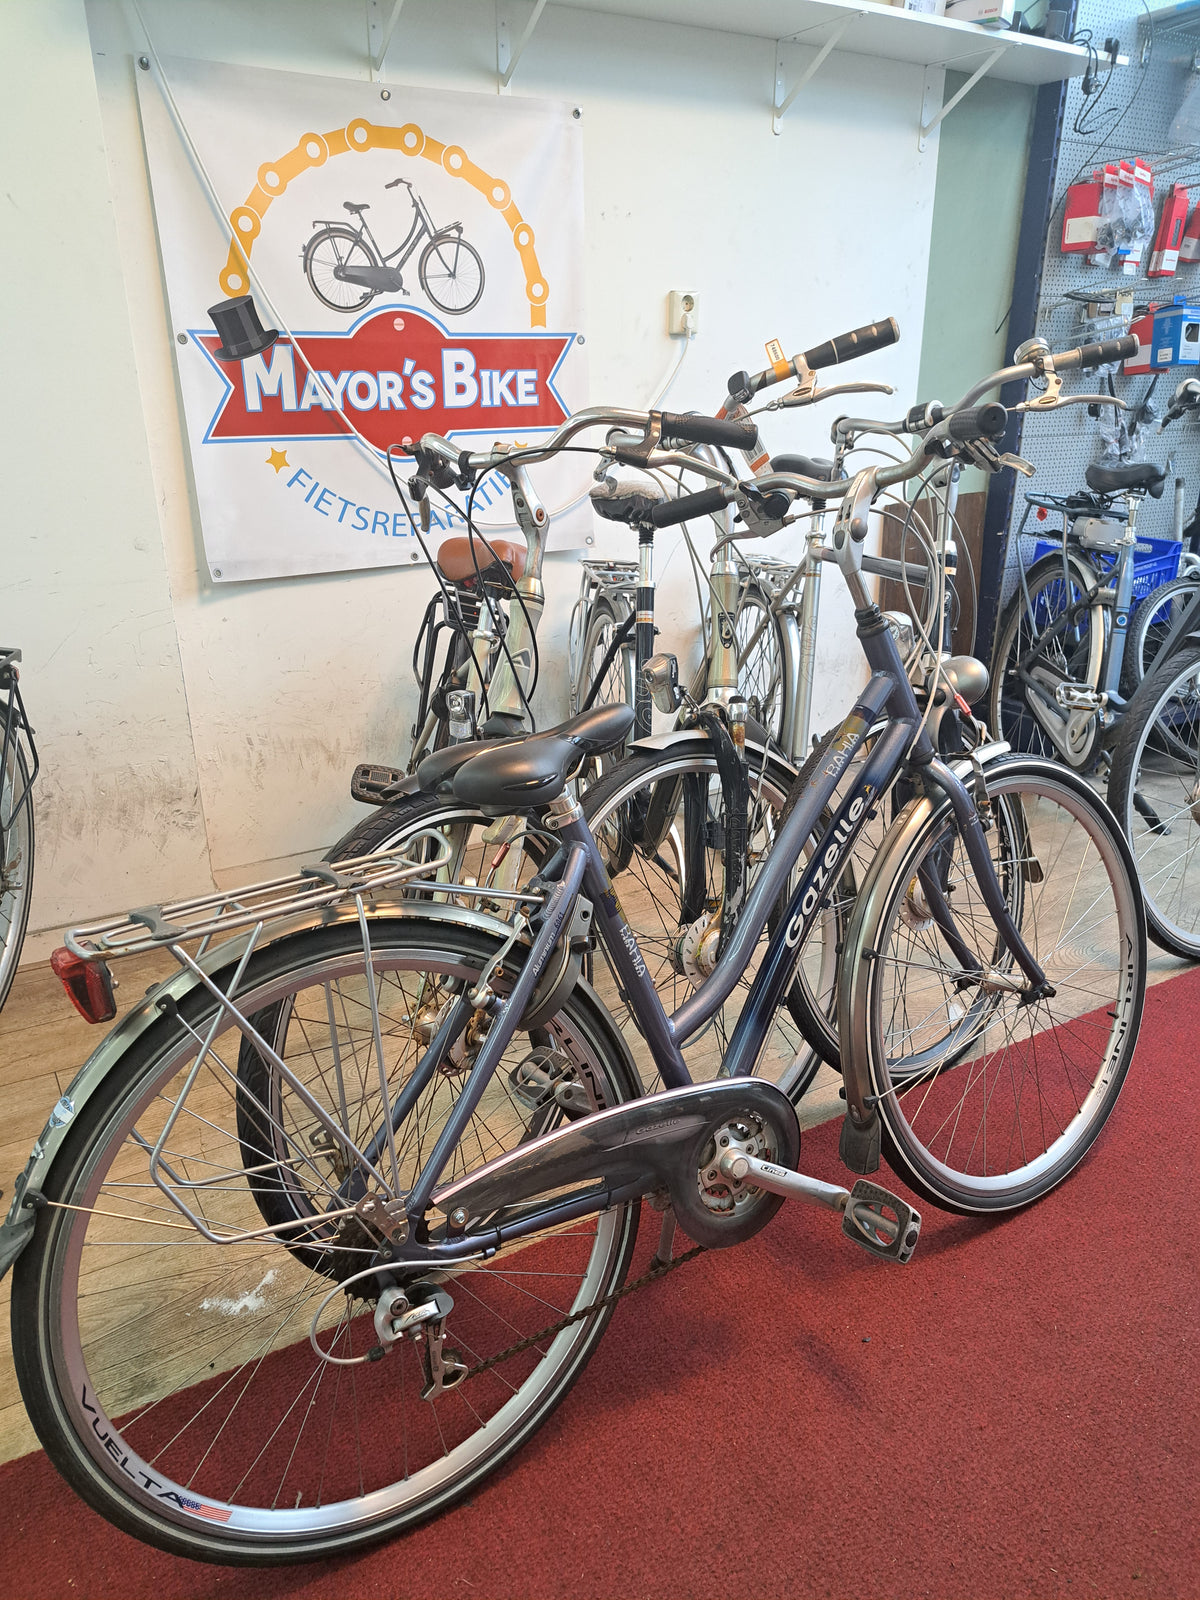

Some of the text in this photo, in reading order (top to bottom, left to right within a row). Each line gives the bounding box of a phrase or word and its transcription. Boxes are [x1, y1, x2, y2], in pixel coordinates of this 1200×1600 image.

[240, 343, 540, 412] MAYOR'S BIKE
[826, 732, 860, 778] BAHIA
[785, 796, 864, 948] Gazelle
[531, 932, 556, 976] Aluminium
[619, 924, 646, 977] BAHIA
[81, 1383, 185, 1509] VUELTA
